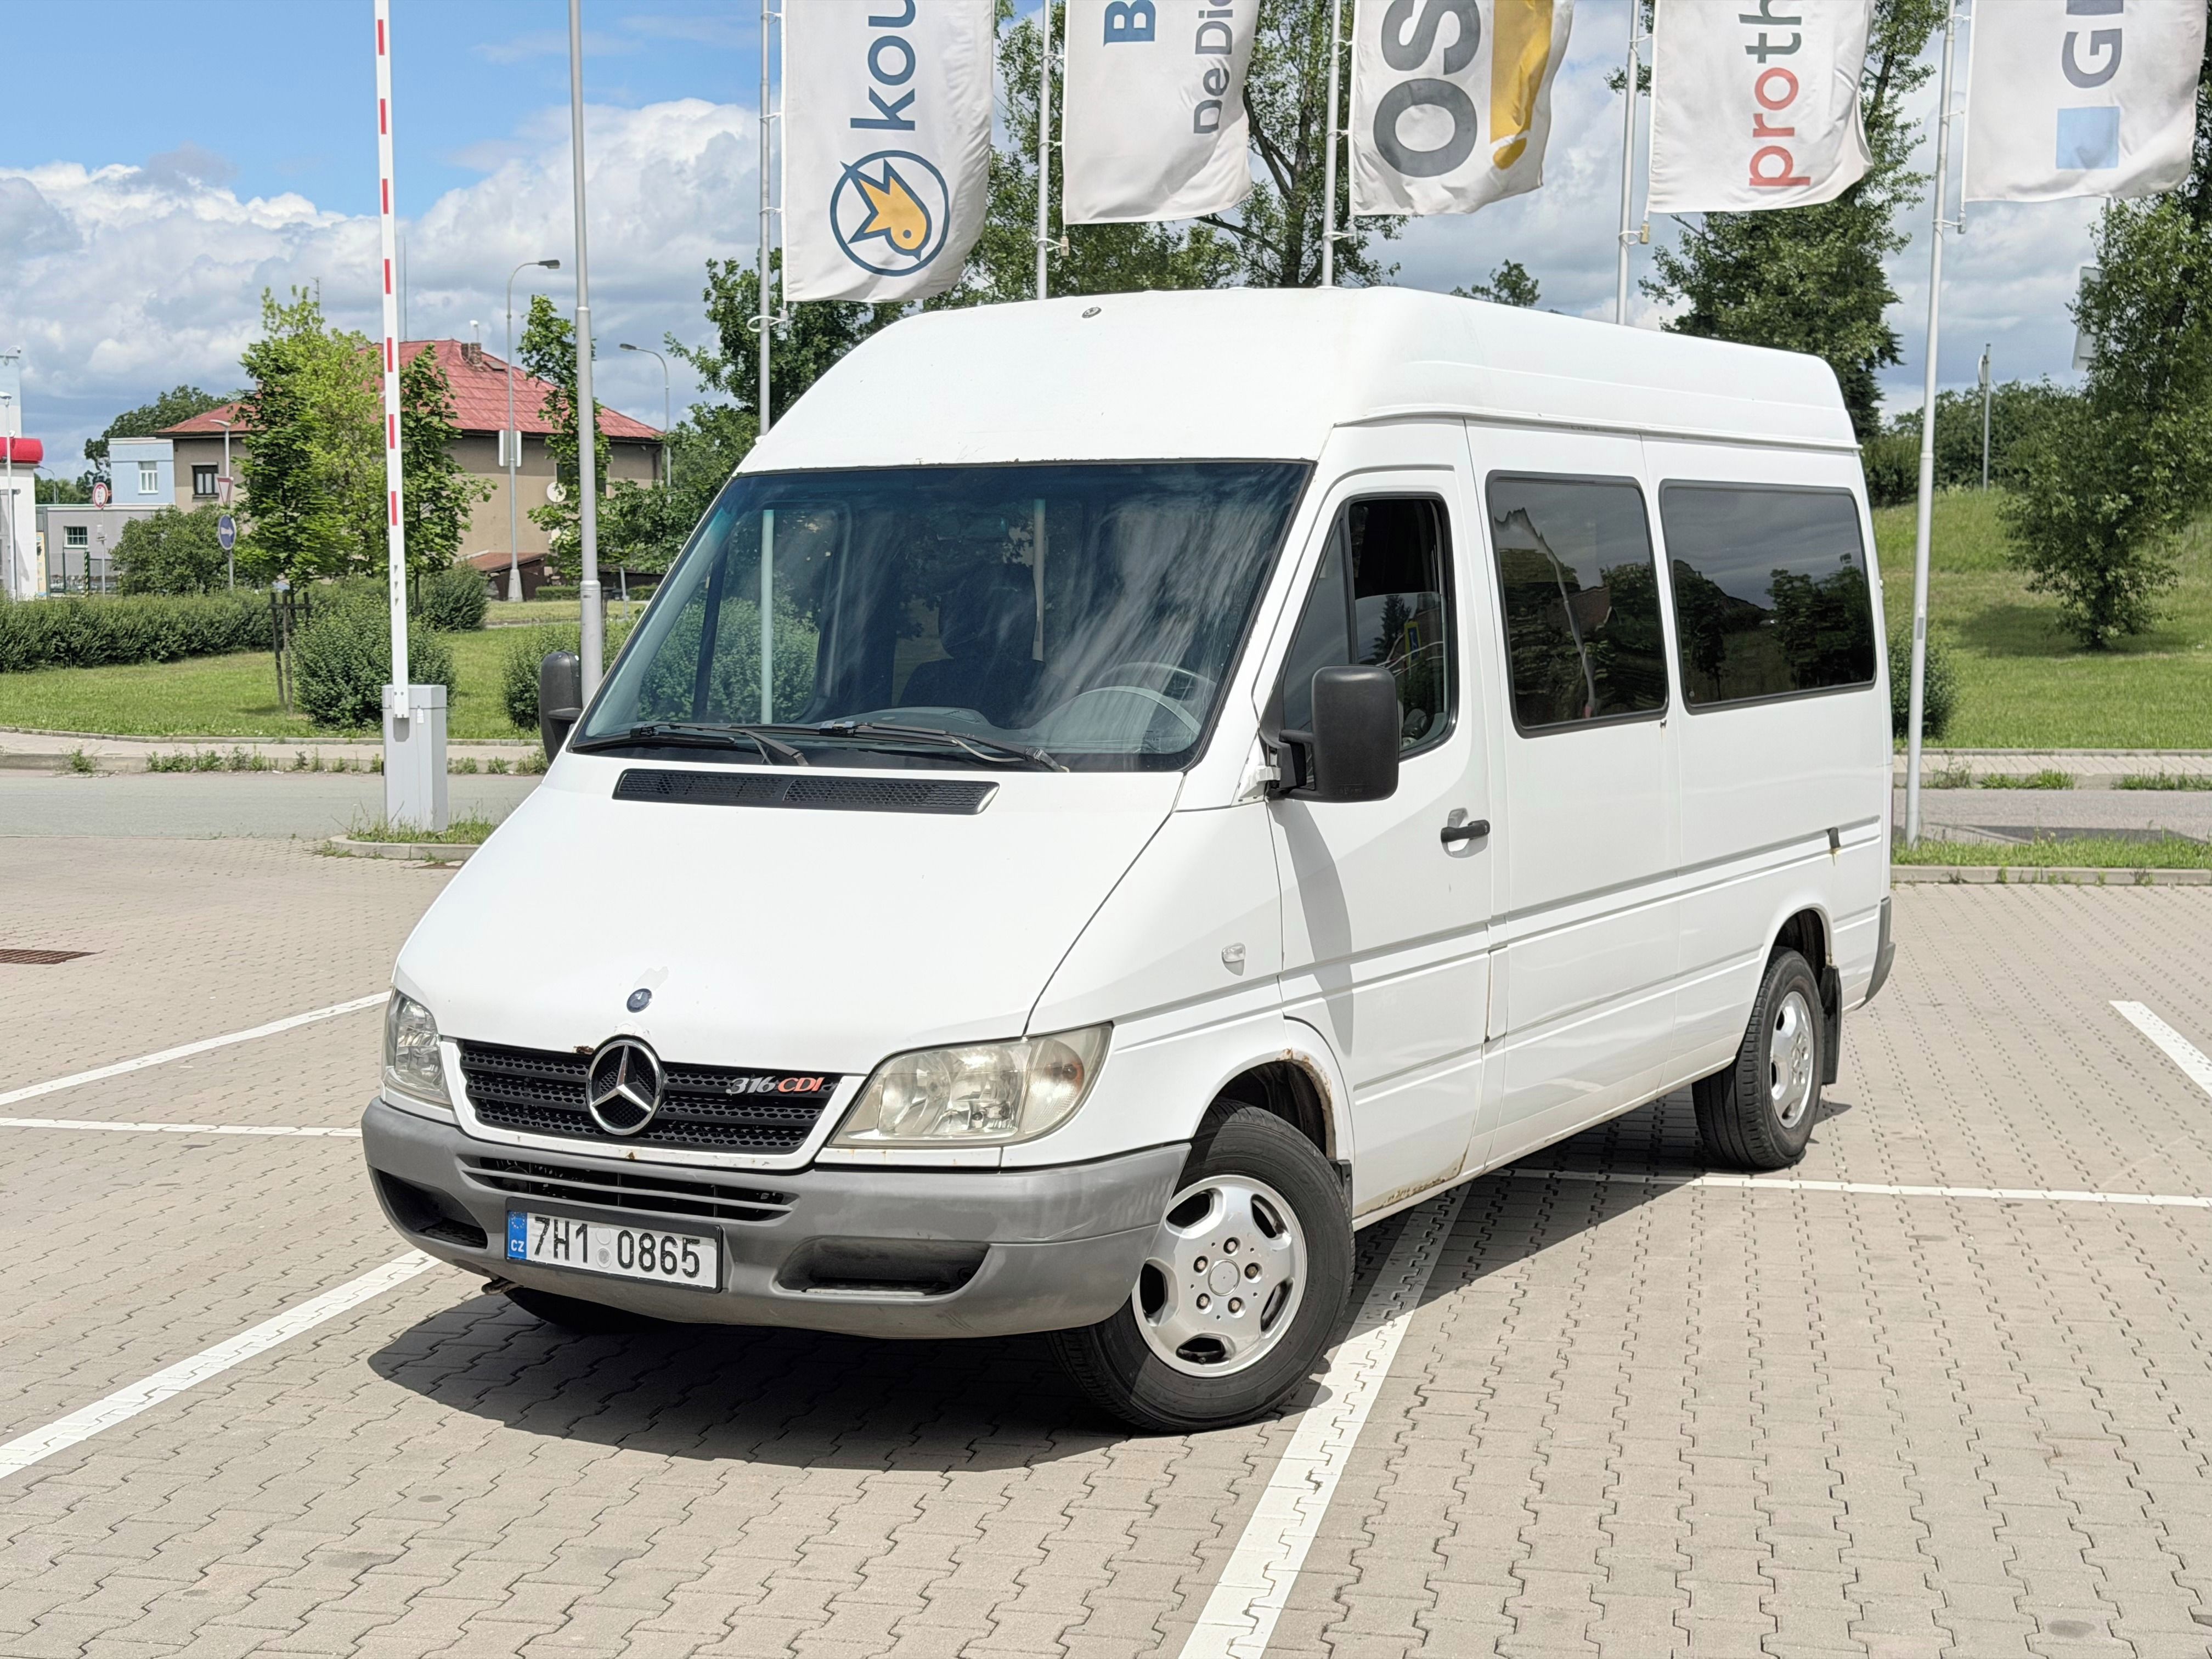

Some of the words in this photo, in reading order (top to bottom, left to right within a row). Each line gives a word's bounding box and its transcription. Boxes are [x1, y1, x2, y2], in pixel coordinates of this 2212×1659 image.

[1103, 0, 1156, 47] B
[1195, 0, 1233, 55] Di
[1373, 0, 1481, 178] OS
[725, 1076, 776, 1094] 316
[777, 1077, 825, 1093] CDI
[510, 1239, 525, 1253] CZ
[534, 1216, 588, 1264] 7H1
[617, 1229, 701, 1278] 0865
